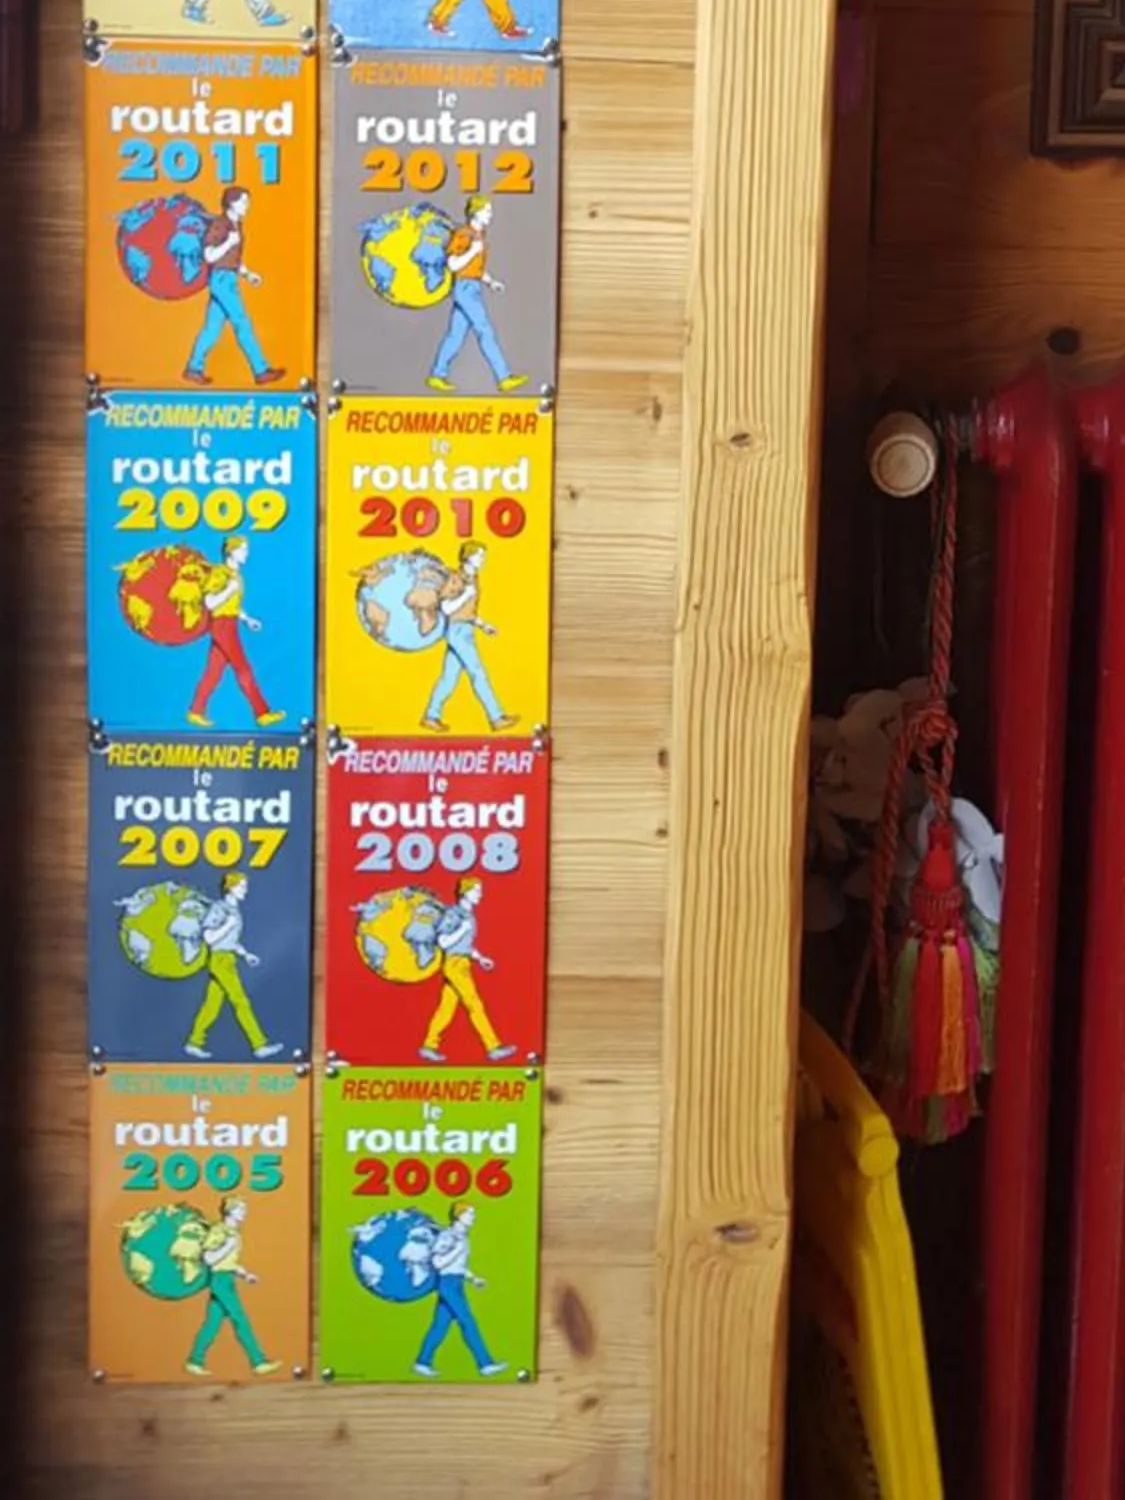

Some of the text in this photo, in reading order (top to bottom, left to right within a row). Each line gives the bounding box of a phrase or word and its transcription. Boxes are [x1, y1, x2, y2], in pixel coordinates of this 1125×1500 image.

[191, 77, 212, 98] le
[504, 63, 546, 88] PAR
[437, 88, 458, 108] le
[110, 100, 294, 137] routard
[356, 110, 537, 146] routard
[117, 137, 282, 184] 2011
[359, 146, 535, 195] 2012
[257, 404, 301, 430] PAR
[346, 407, 538, 435] RECOMMANDÉ PAR
[191, 428, 212, 448] le
[430, 435, 452, 455] le
[111, 451, 292, 485] routard
[351, 456, 530, 492] routard
[114, 486, 289, 531] 2009
[357, 495, 527, 539] 2010
[107, 740, 300, 770] RECOMMANDÉ PAR
[344, 745, 535, 774] RECOMMANDÉ PAR
[192, 767, 213, 788] le
[428, 773, 449, 793] le
[113, 790, 292, 824] routard
[350, 794, 526, 829] routard
[118, 824, 288, 868] 2007
[354, 831, 520, 873] 2008
[191, 1094, 212, 1114] le
[487, 1079, 527, 1102] PAR
[422, 1101, 443, 1120] le
[114, 1115, 289, 1148] routard
[346, 1122, 518, 1156] routard
[122, 1151, 284, 1193] 2005
[352, 1157, 513, 1198] 2006
